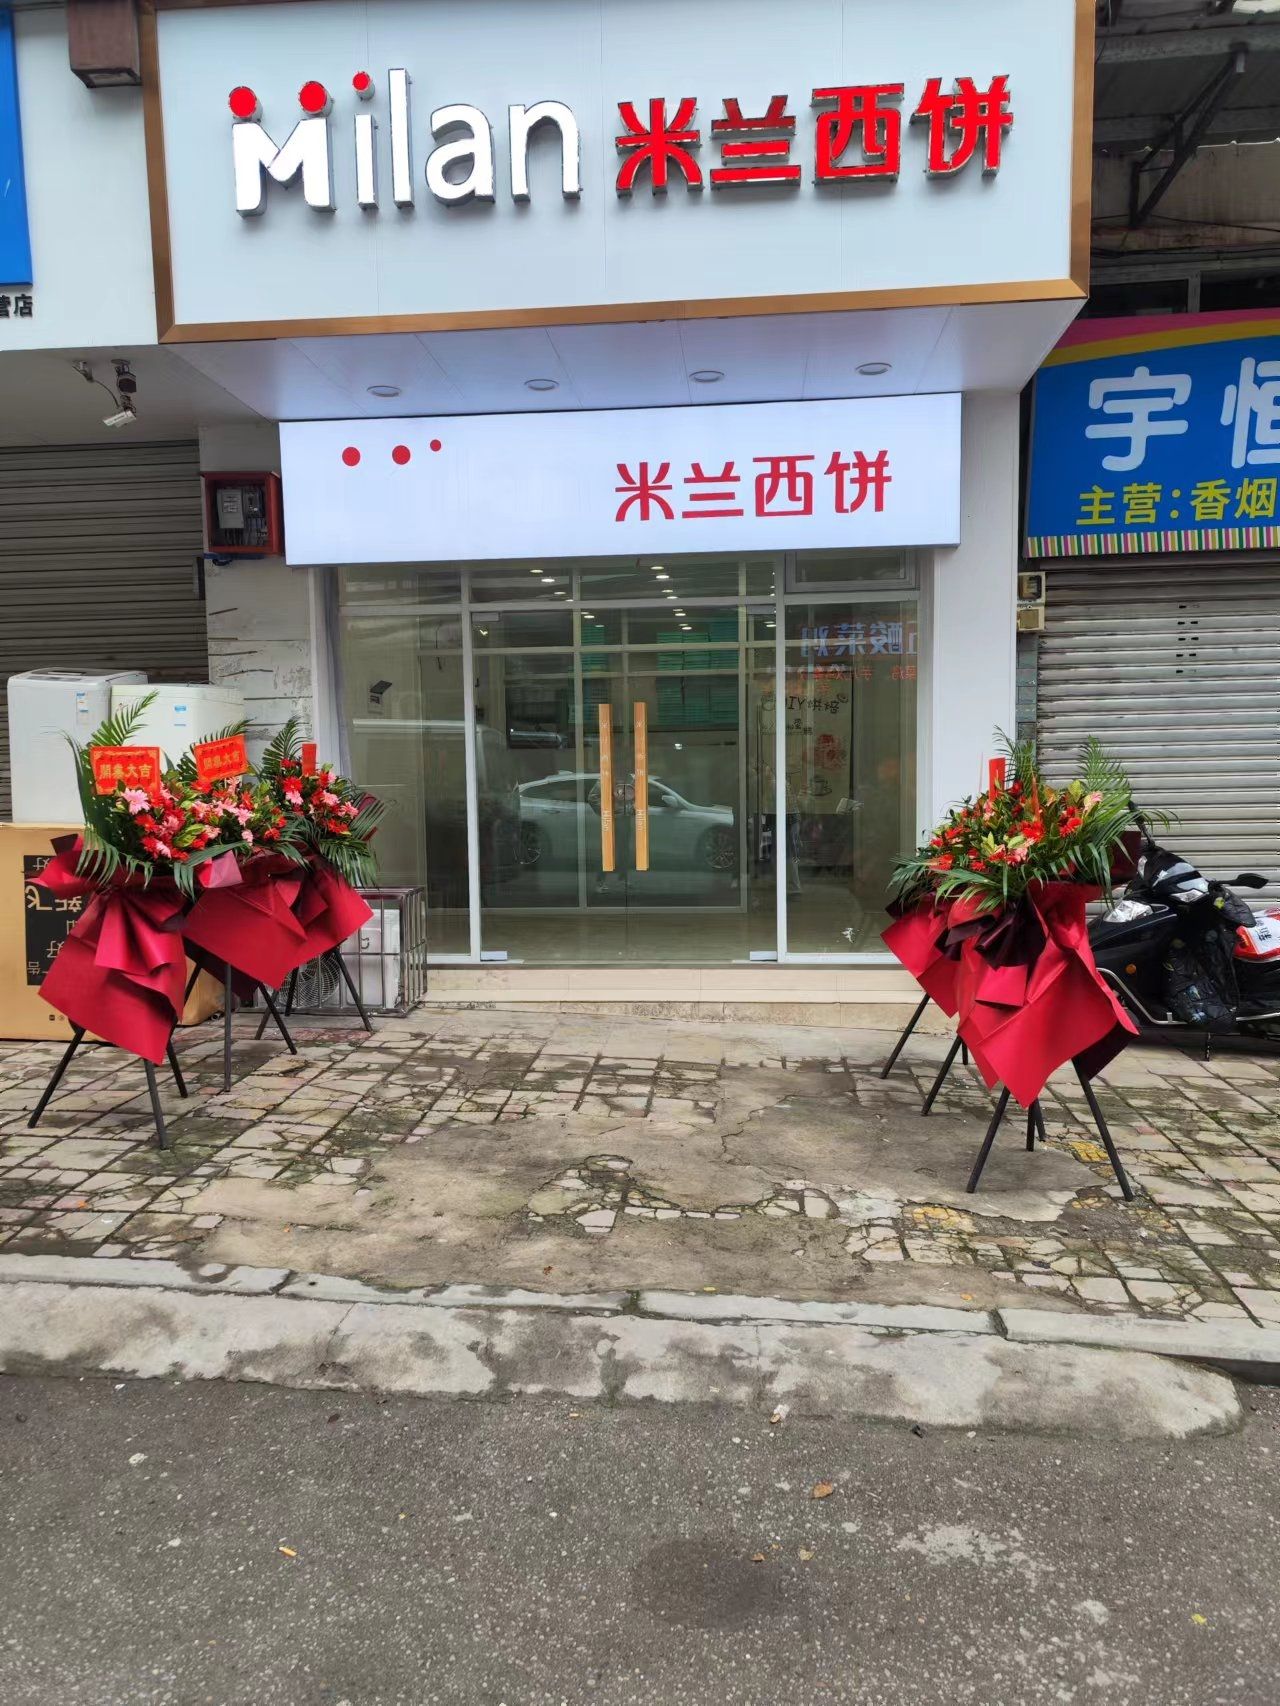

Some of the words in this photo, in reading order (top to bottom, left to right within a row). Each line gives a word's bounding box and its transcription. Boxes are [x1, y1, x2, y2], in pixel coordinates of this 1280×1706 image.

[228, 68, 583, 217] Milan
[614, 75, 1014, 197] 米兰西饼
[1085, 357, 1280, 472] 宇恒
[615, 450, 892, 522] 米兰西饼
